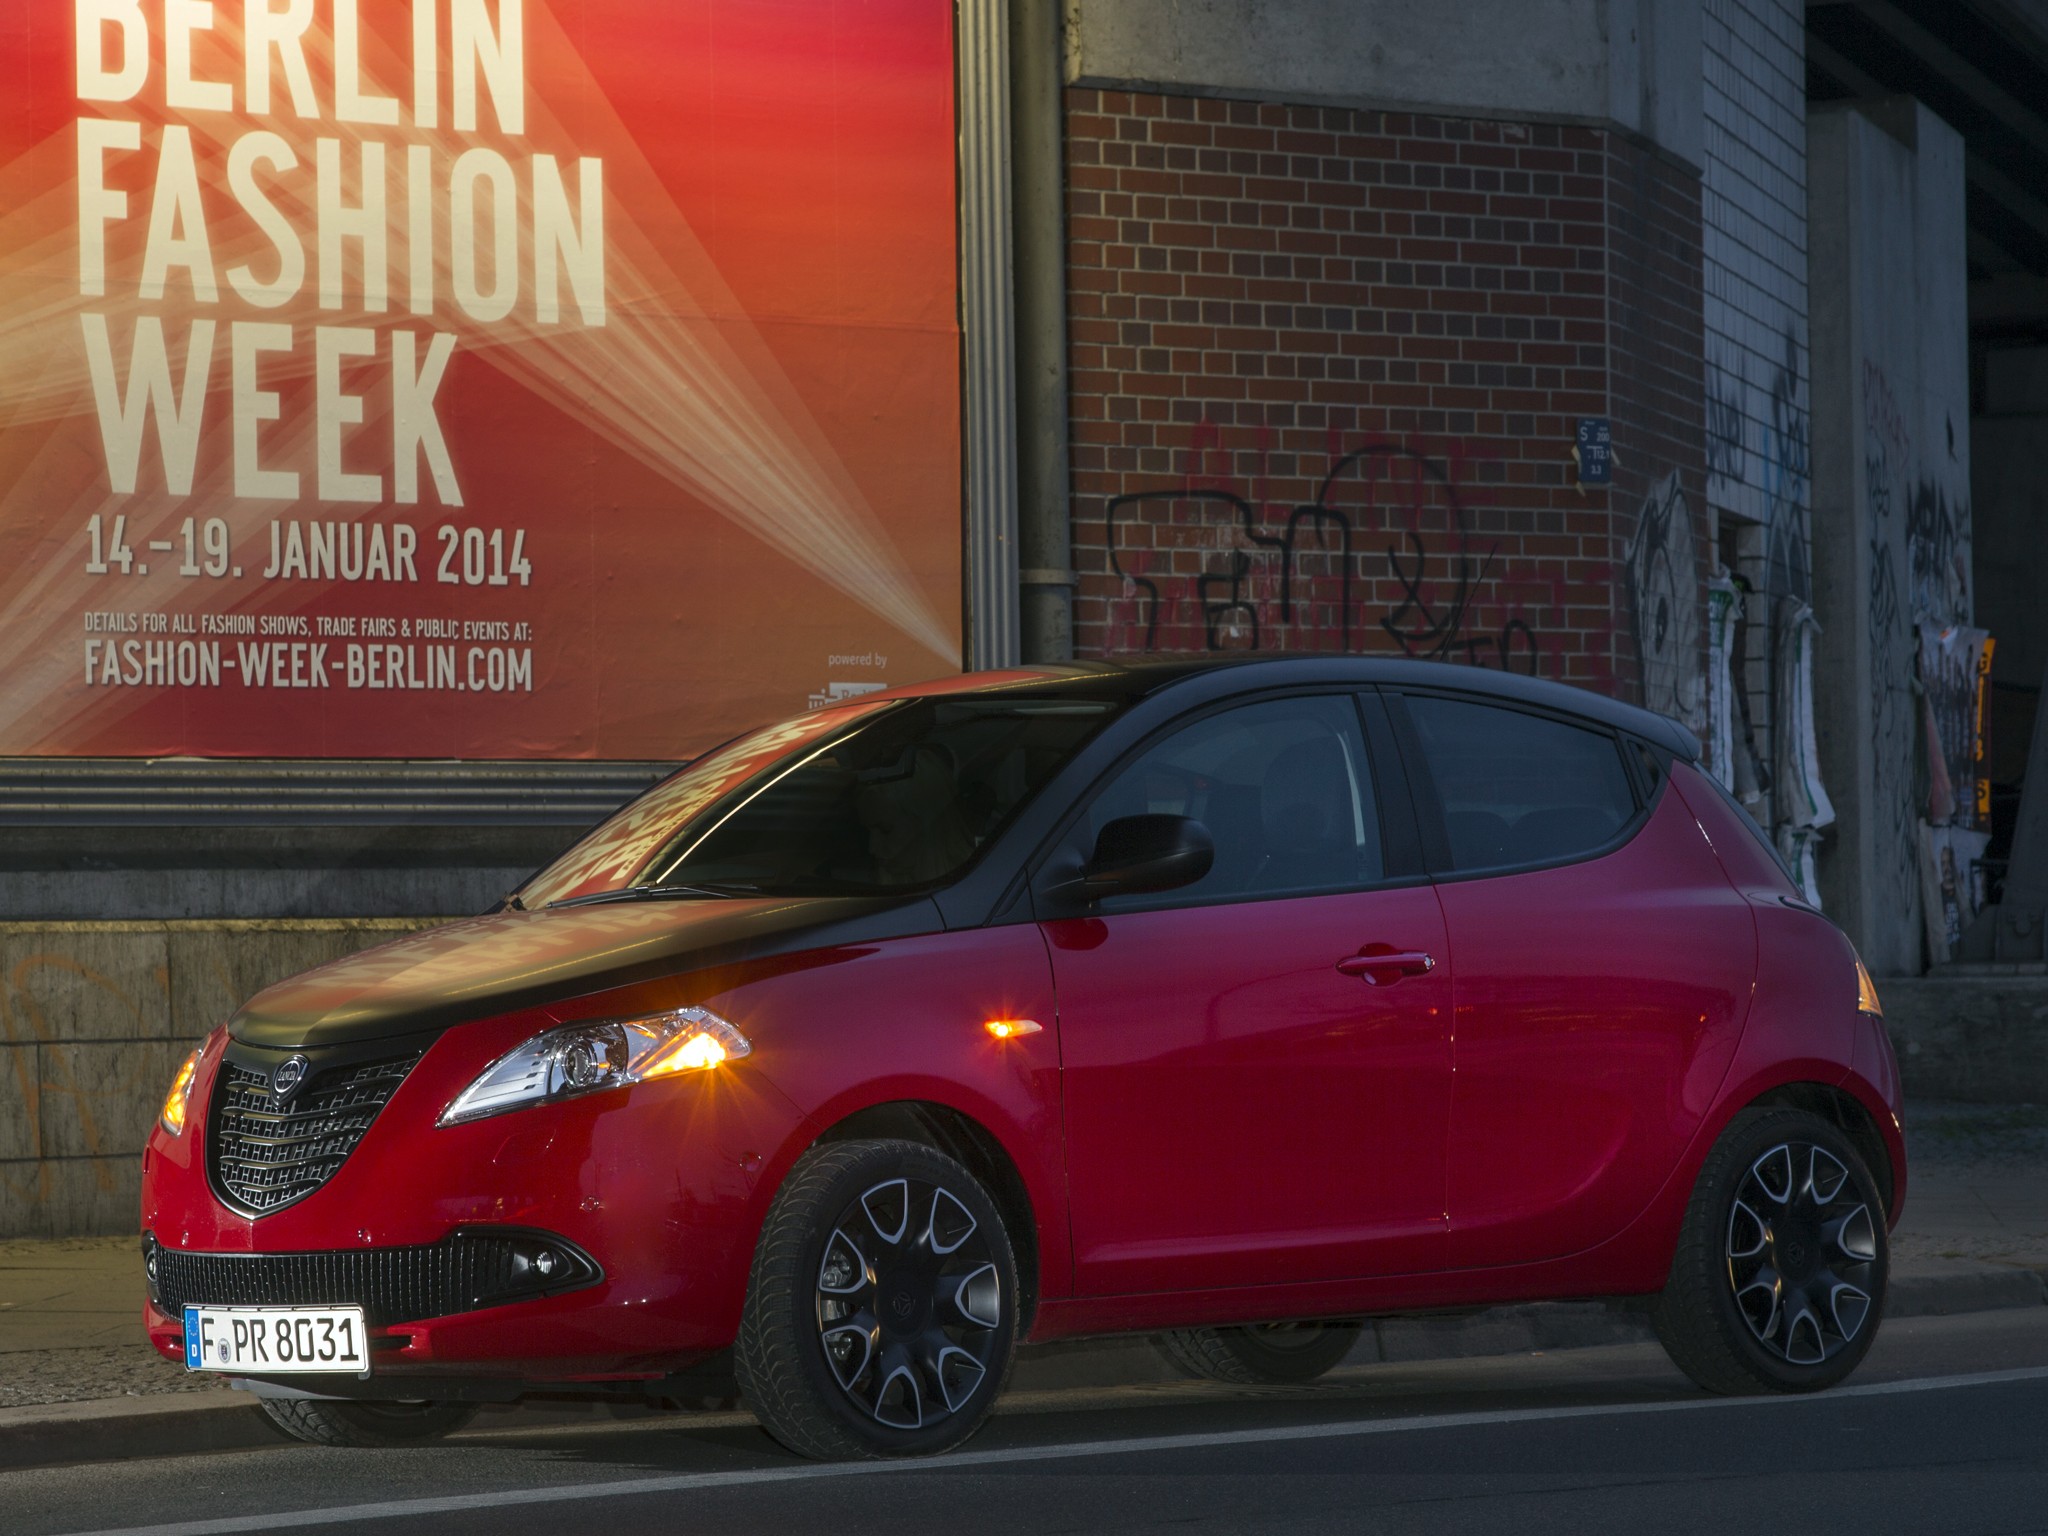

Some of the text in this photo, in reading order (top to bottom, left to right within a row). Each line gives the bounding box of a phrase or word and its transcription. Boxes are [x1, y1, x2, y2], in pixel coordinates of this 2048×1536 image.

[75, 0, 525, 135] BERLIN
[76, 116, 607, 328] FASHION
[79, 312, 465, 507] WEEK
[1580, 426, 1588, 441] S
[263, 519, 418, 582] JANUAR
[437, 525, 532, 586] 2014
[84, 612, 533, 641] DETAILS FOR ALL FASHION SHOWS, TRADE FAIRS & PUBLIC EVENTS AT:
[84, 638, 533, 692] FASHION-WEEK-BERLIN.COM
[828, 652, 888, 668] powered by
[201, 1317, 360, 1363] F PR 8031
